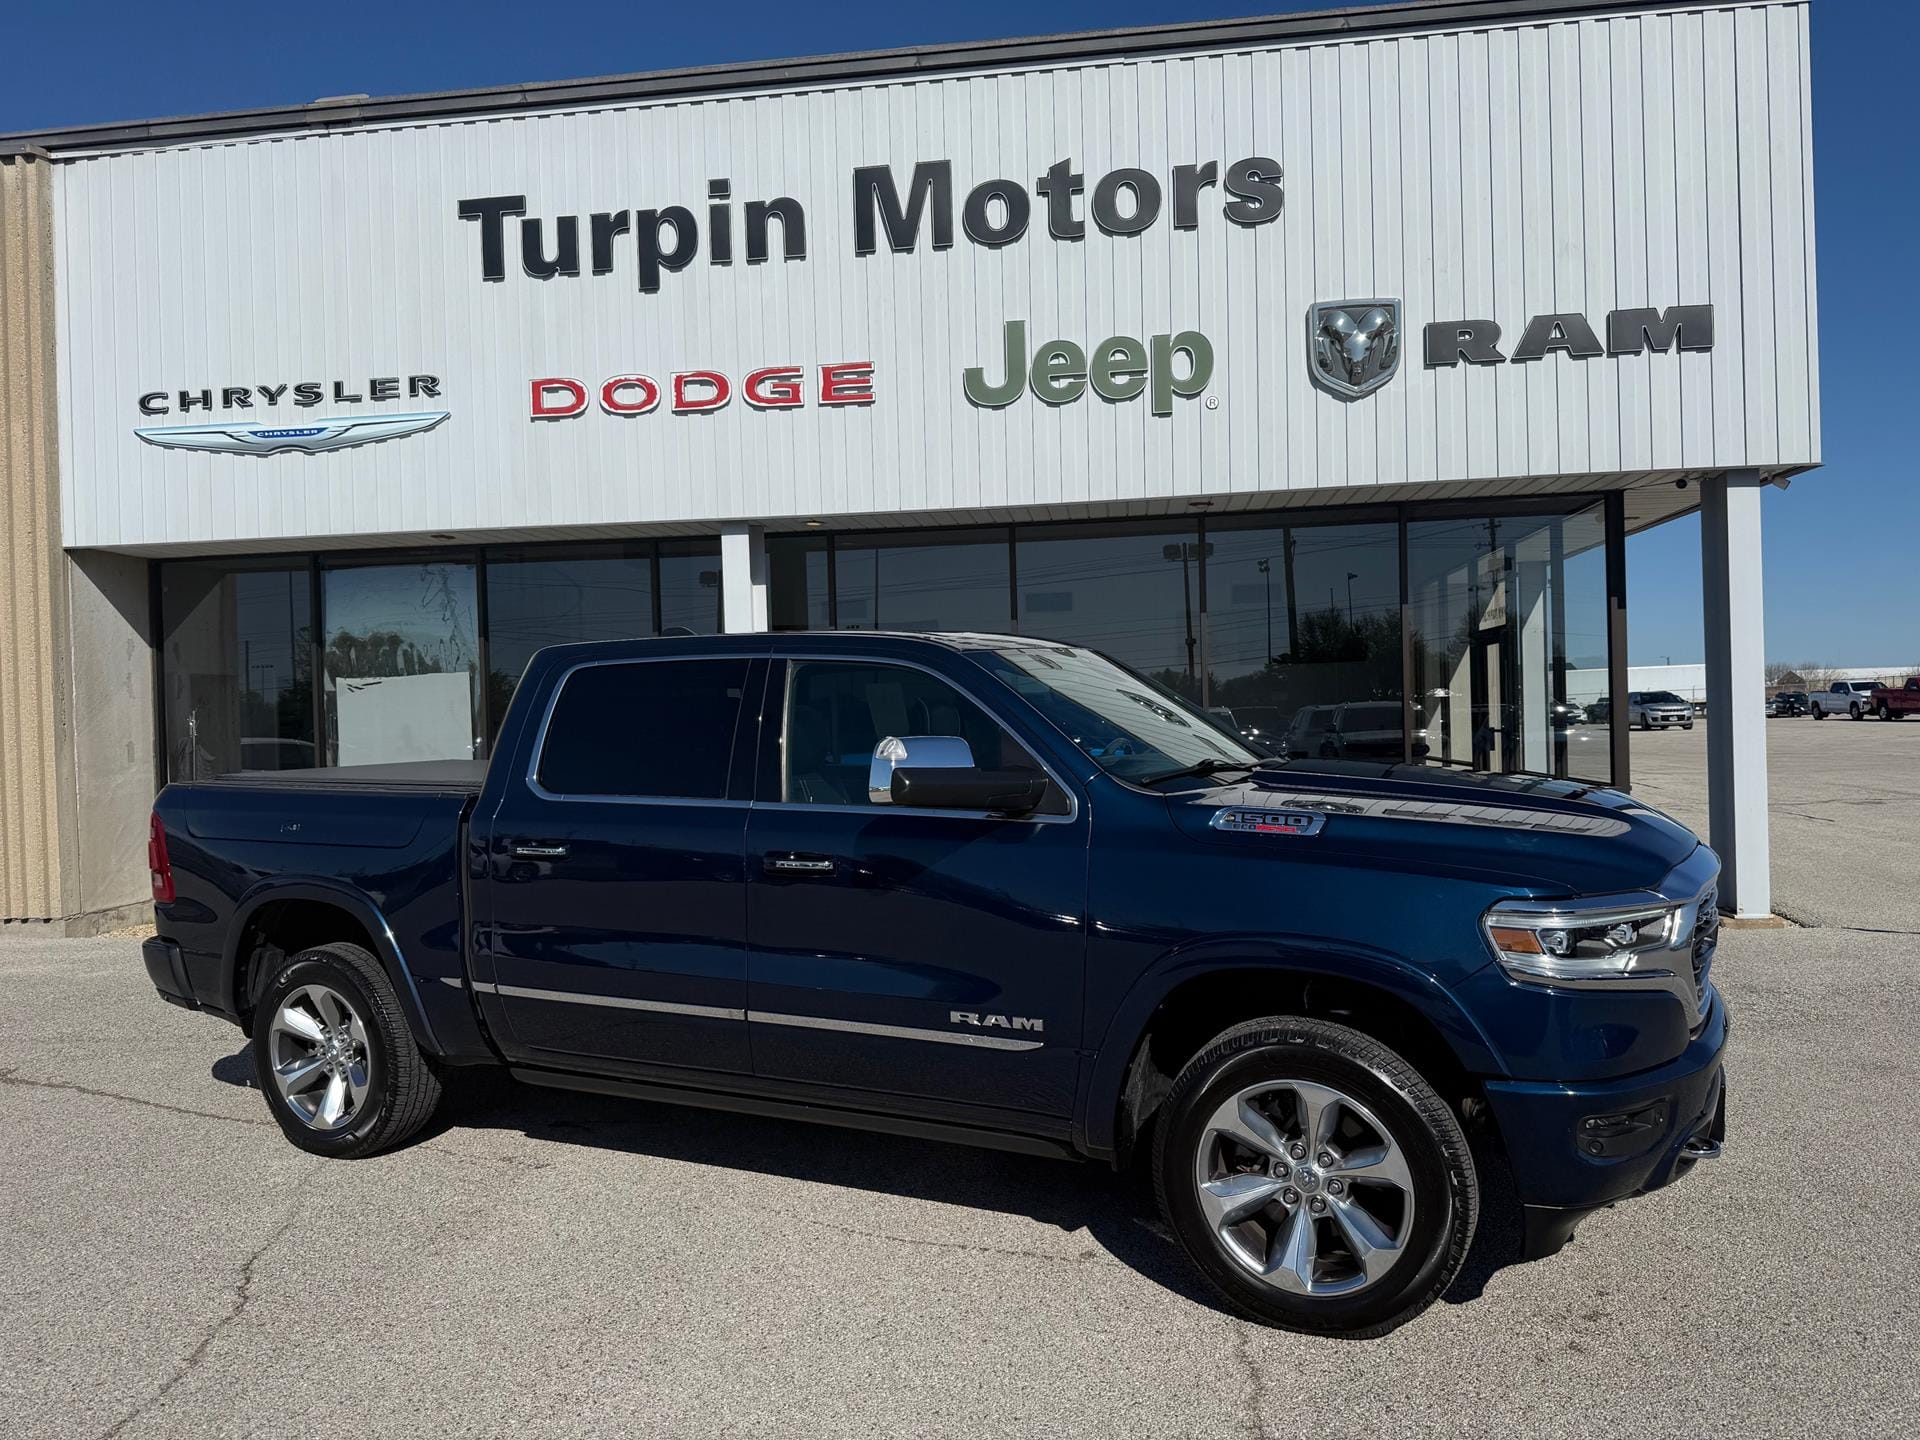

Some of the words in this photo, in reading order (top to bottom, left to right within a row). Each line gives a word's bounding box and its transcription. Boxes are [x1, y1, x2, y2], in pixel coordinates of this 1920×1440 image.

[457, 178, 807, 292] Turpin
[852, 156, 1284, 255] Motors
[1424, 303, 1714, 367] RAM
[529, 361, 875, 420] DODGE
[963, 320, 1214, 415] Jeep
[138, 374, 442, 415] CHRYSLER
[256, 429, 318, 437] CHRYSLER
[1232, 812, 1308, 826] 1500
[950, 1010, 1044, 1032] RAM
